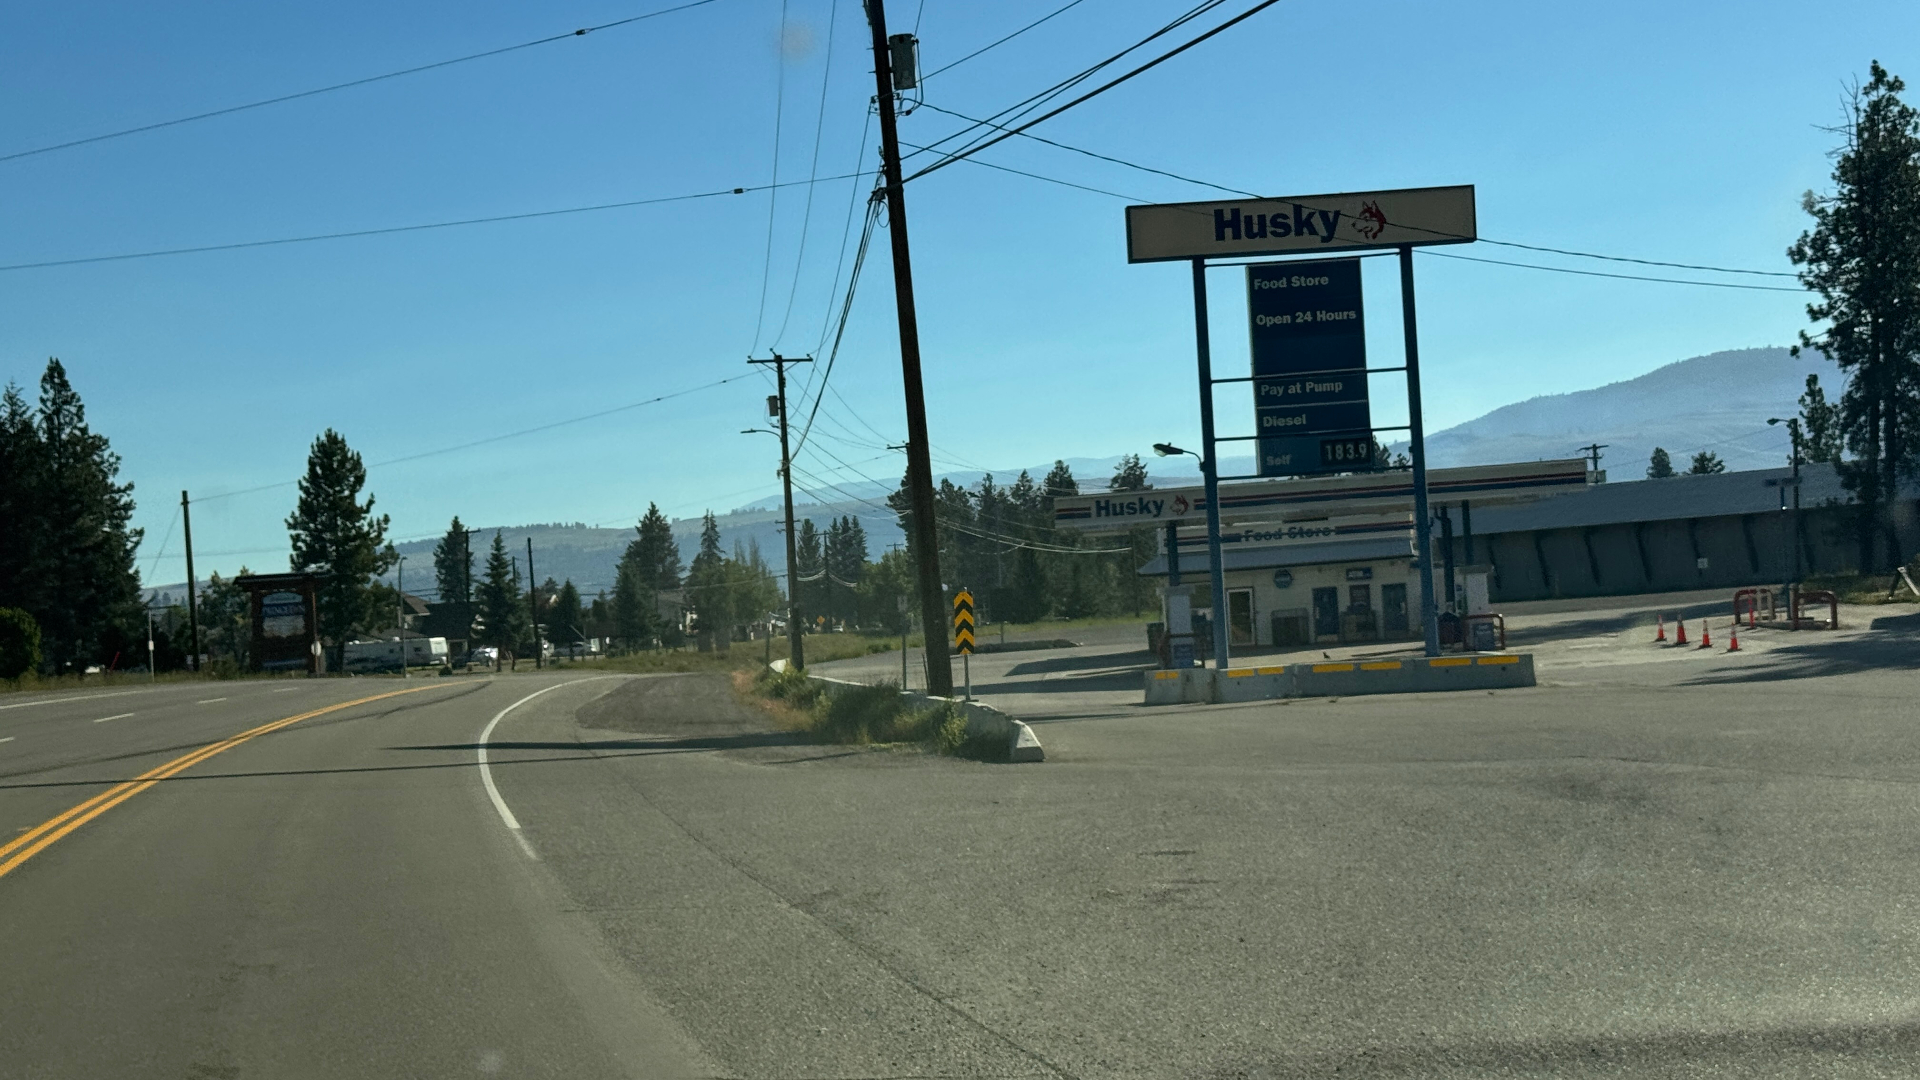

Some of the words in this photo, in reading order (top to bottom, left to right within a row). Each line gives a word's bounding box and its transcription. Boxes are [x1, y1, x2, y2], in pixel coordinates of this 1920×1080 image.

[1213, 203, 1341, 243] Husky
[1254, 277, 1287, 290] Food
[1291, 275, 1329, 287] Store
[1256, 313, 1291, 327] Open
[1295, 311, 1313, 323] 24
[1316, 309, 1356, 321] Hours
[1260, 384, 1284, 397] Pay
[1287, 382, 1302, 394] at
[1305, 380, 1343, 393] Pump
[1263, 413, 1307, 428] Diesel
[1266, 454, 1292, 466] Self
[1324, 443, 1367, 461] 183.9
[1095, 498, 1165, 518] Husky
[1243, 528, 1283, 543] Food
[1287, 525, 1331, 540] Store
